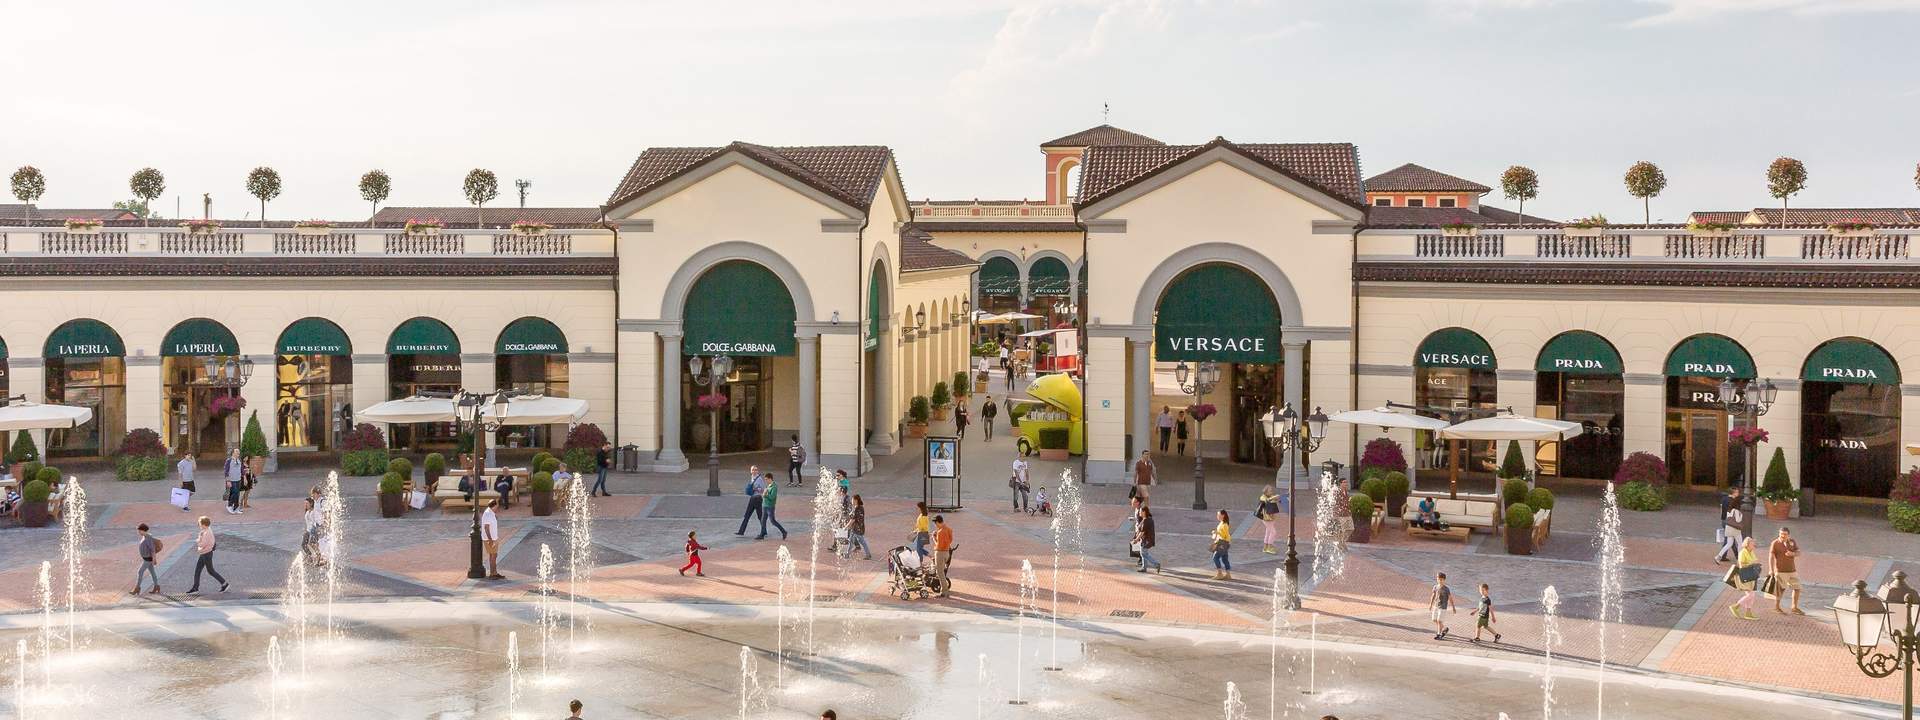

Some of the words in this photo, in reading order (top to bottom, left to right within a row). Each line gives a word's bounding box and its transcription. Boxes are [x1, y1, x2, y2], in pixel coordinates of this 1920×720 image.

[59, 345, 72, 354] LA
[74, 344, 110, 354] PERLA
[176, 344, 188, 353] LA
[190, 344, 224, 353] PERLA
[1169, 337, 1265, 352] VERSACE
[1422, 353, 1489, 365] VERSACE
[1555, 358, 1603, 369] PRADA
[1684, 363, 1735, 374] PRADA
[1823, 367, 1878, 379] PRADA
[1820, 439, 1868, 450] PRADA
